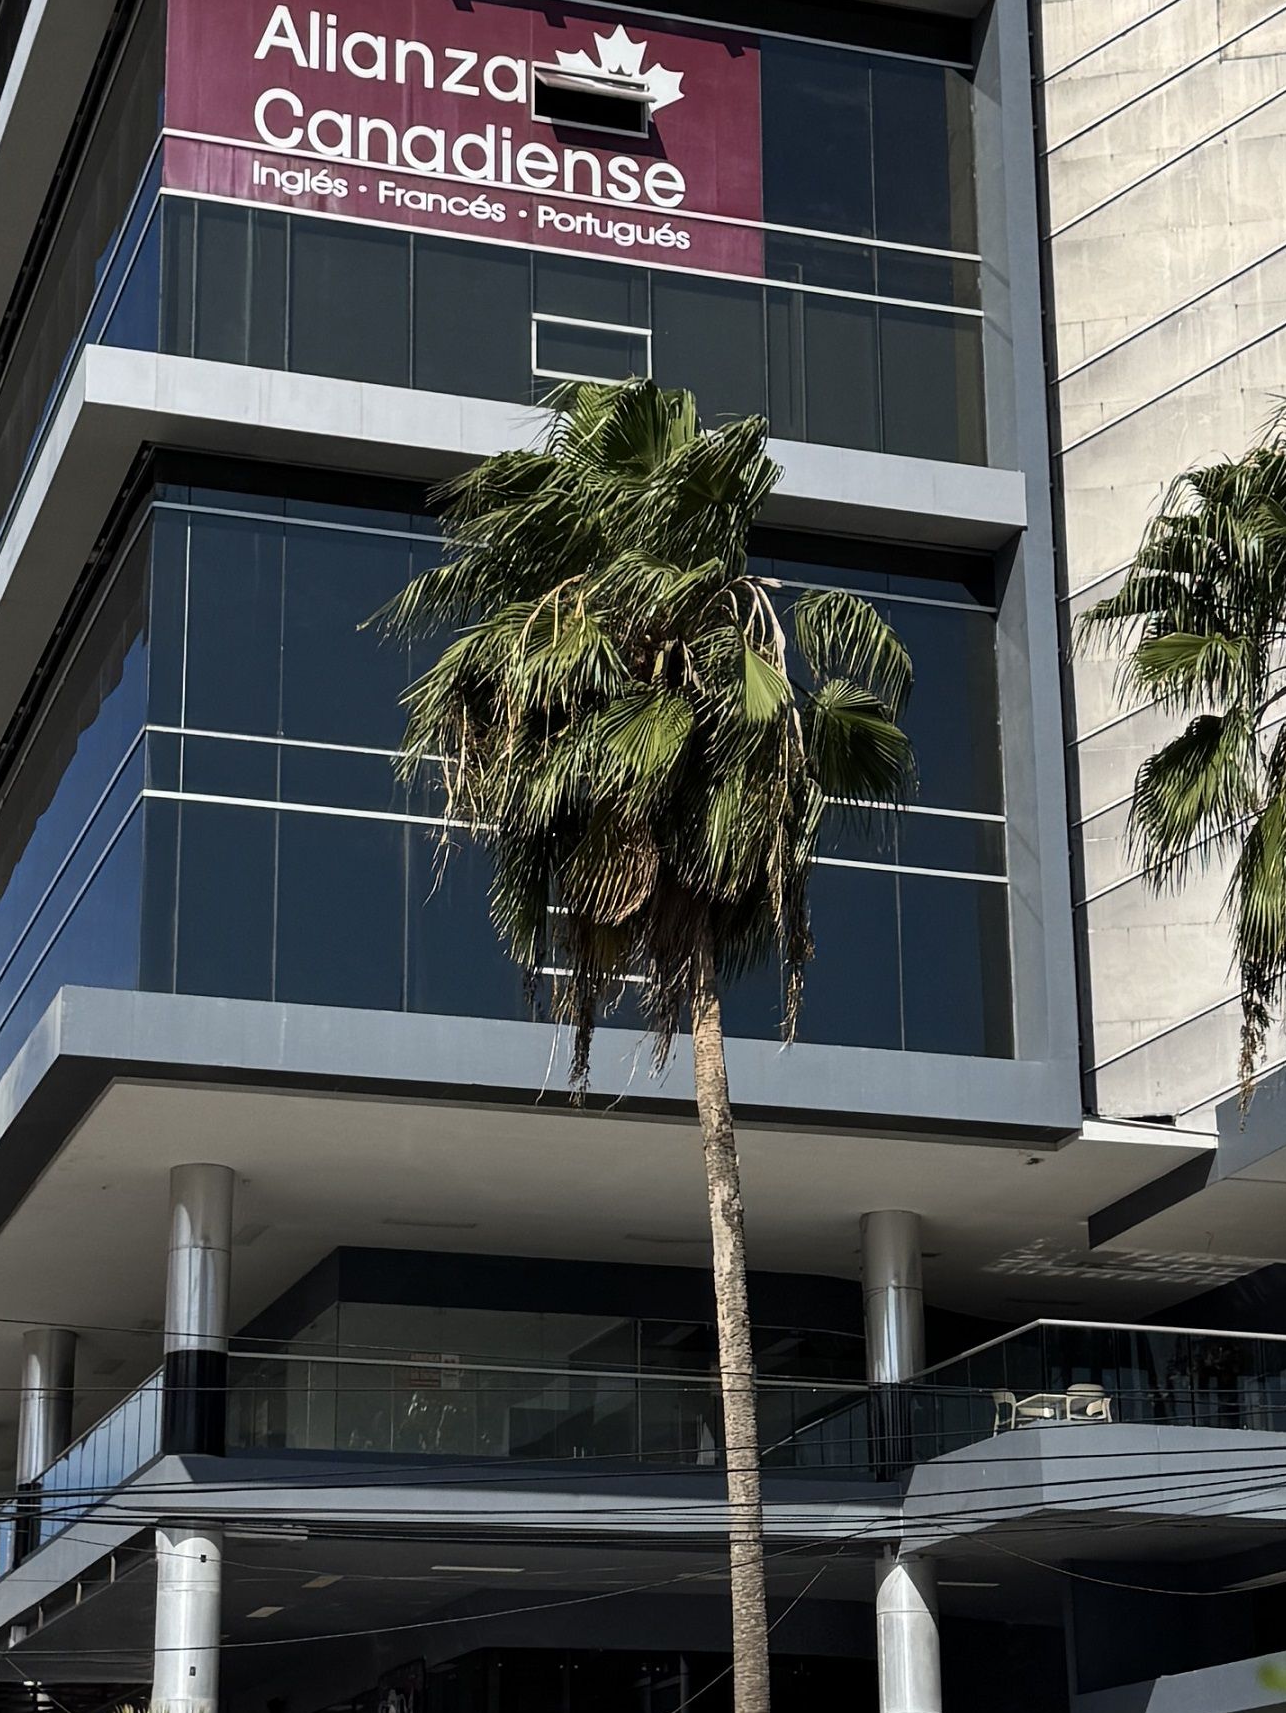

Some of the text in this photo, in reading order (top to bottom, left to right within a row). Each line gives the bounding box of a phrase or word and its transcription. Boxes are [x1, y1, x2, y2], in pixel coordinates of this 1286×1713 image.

[253, 4, 528, 104] Alianza
[253, 87, 687, 208] Canadiense
[252, 160, 691, 251] Inglés Francés Portugués
